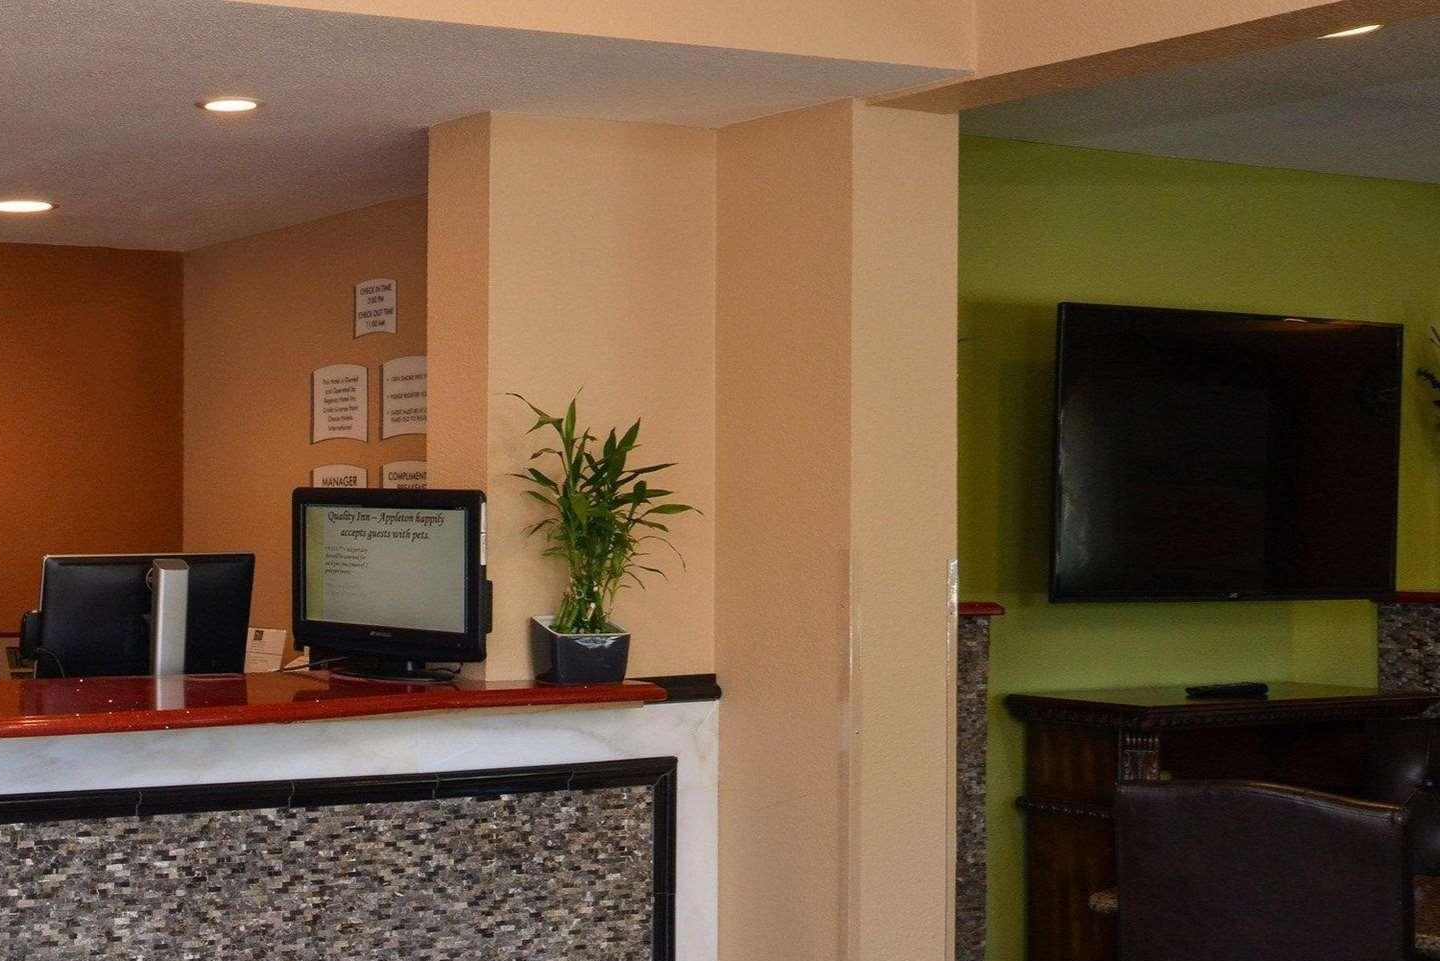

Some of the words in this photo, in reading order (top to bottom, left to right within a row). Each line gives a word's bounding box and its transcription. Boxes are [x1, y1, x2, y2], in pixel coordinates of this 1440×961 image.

[322, 476, 358, 487] MANAGER
[388, 471, 427, 481] COMPLIMENT
[328, 511, 355, 524] Quality
[356, 511, 370, 521] Inn
[377, 512, 414, 525] Appleton
[415, 512, 445, 527] happily
[340, 529, 366, 540] accepts
[367, 529, 391, 540] guests
[392, 528, 411, 538] with
